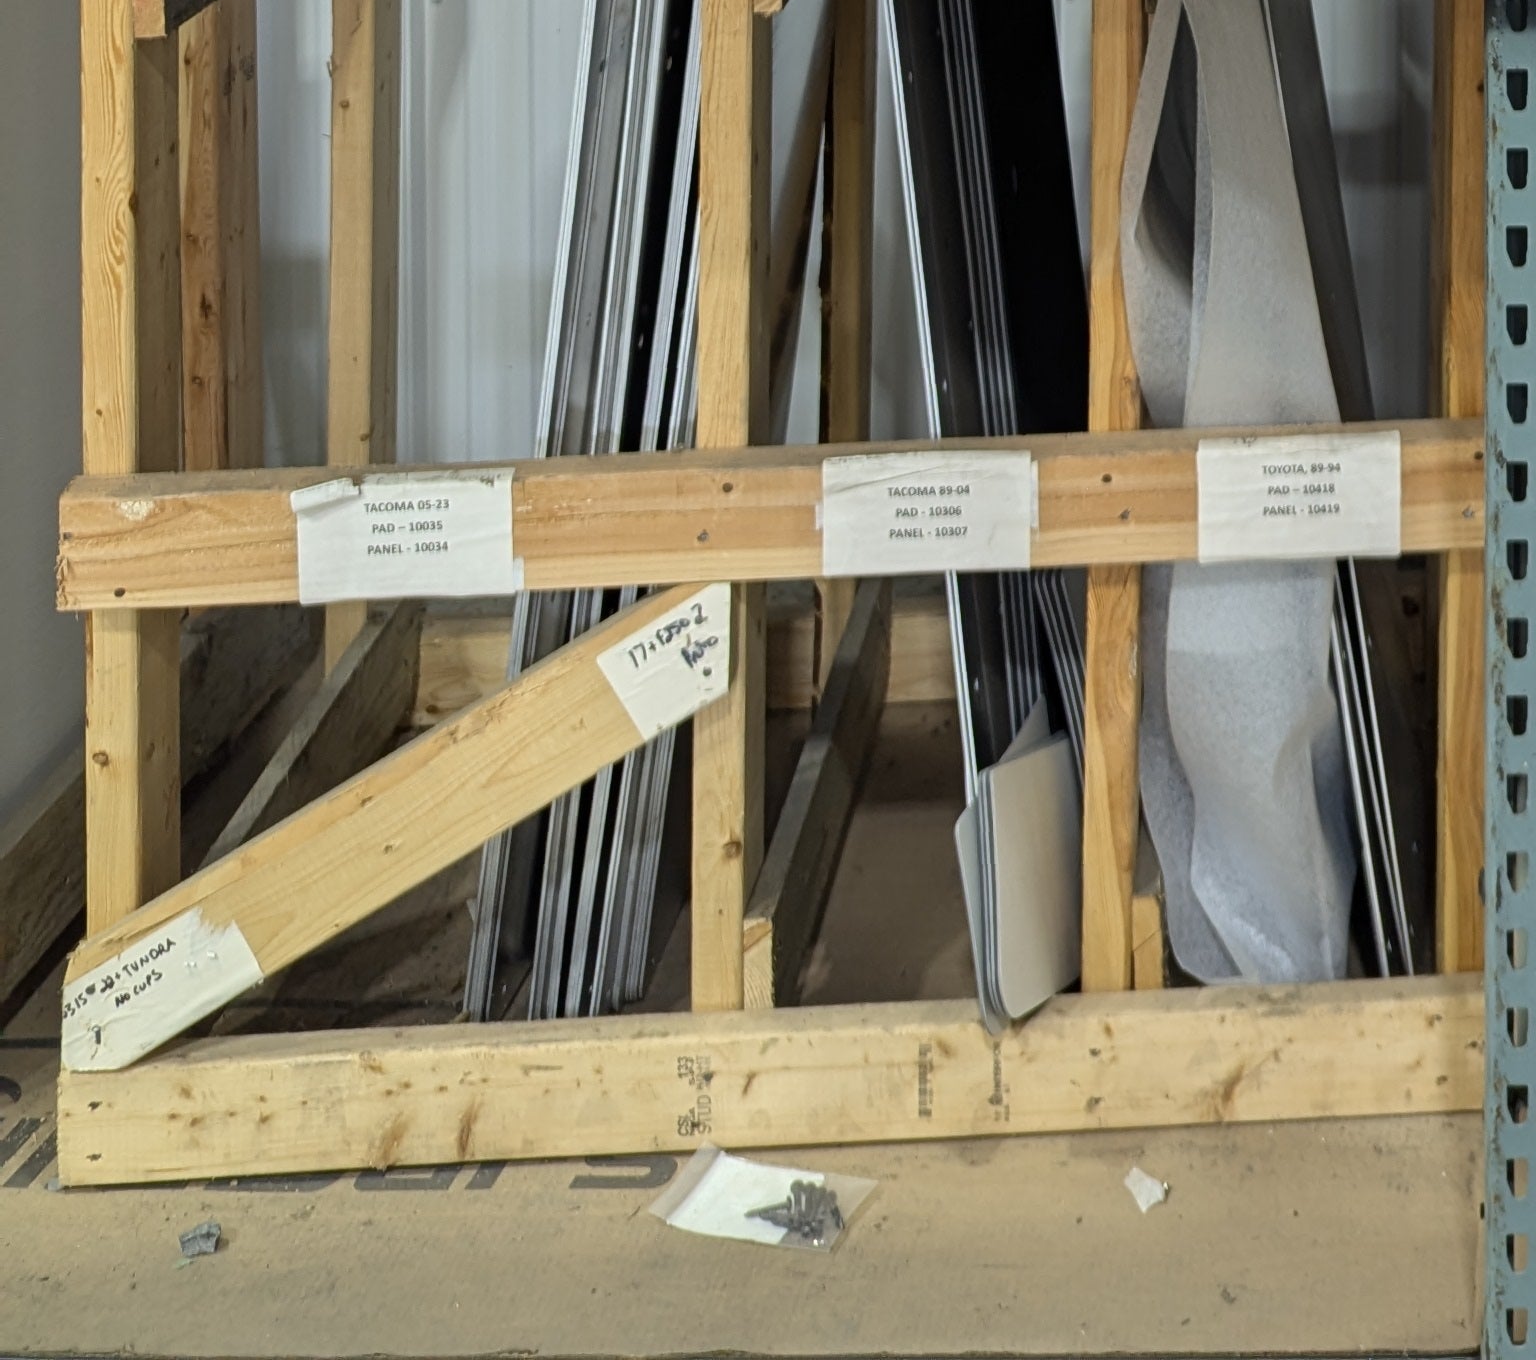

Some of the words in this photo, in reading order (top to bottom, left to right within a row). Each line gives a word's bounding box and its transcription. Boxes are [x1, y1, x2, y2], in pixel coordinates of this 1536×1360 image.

[1262, 464, 1308, 475] TOYOTA,
[1310, 463, 1341, 473] 89-94
[887, 486, 936, 497] TACOMA
[938, 485, 970, 496] 89-04
[1267, 485, 1290, 495] PAD
[1302, 483, 1335, 494] 10418
[364, 501, 415, 513] TACOMA
[417, 499, 450, 511] 05-23
[895, 507, 918, 518] PAD
[929, 505, 962, 517] 10306
[1262, 505, 1297, 516] PANEL
[1307, 503, 1340, 514] 10419
[372, 523, 395, 534] PAD
[409, 521, 443, 532] 10035
[889, 528, 924, 539] PANEL
[934, 526, 968, 537] 10307
[367, 544, 404, 555] PANEL
[414, 541, 448, 553] 10034
[122, 937, 177, 978] TUNDRA
[133, 968, 163, 996] CUPS
[697, 1094, 712, 1134] STUD
